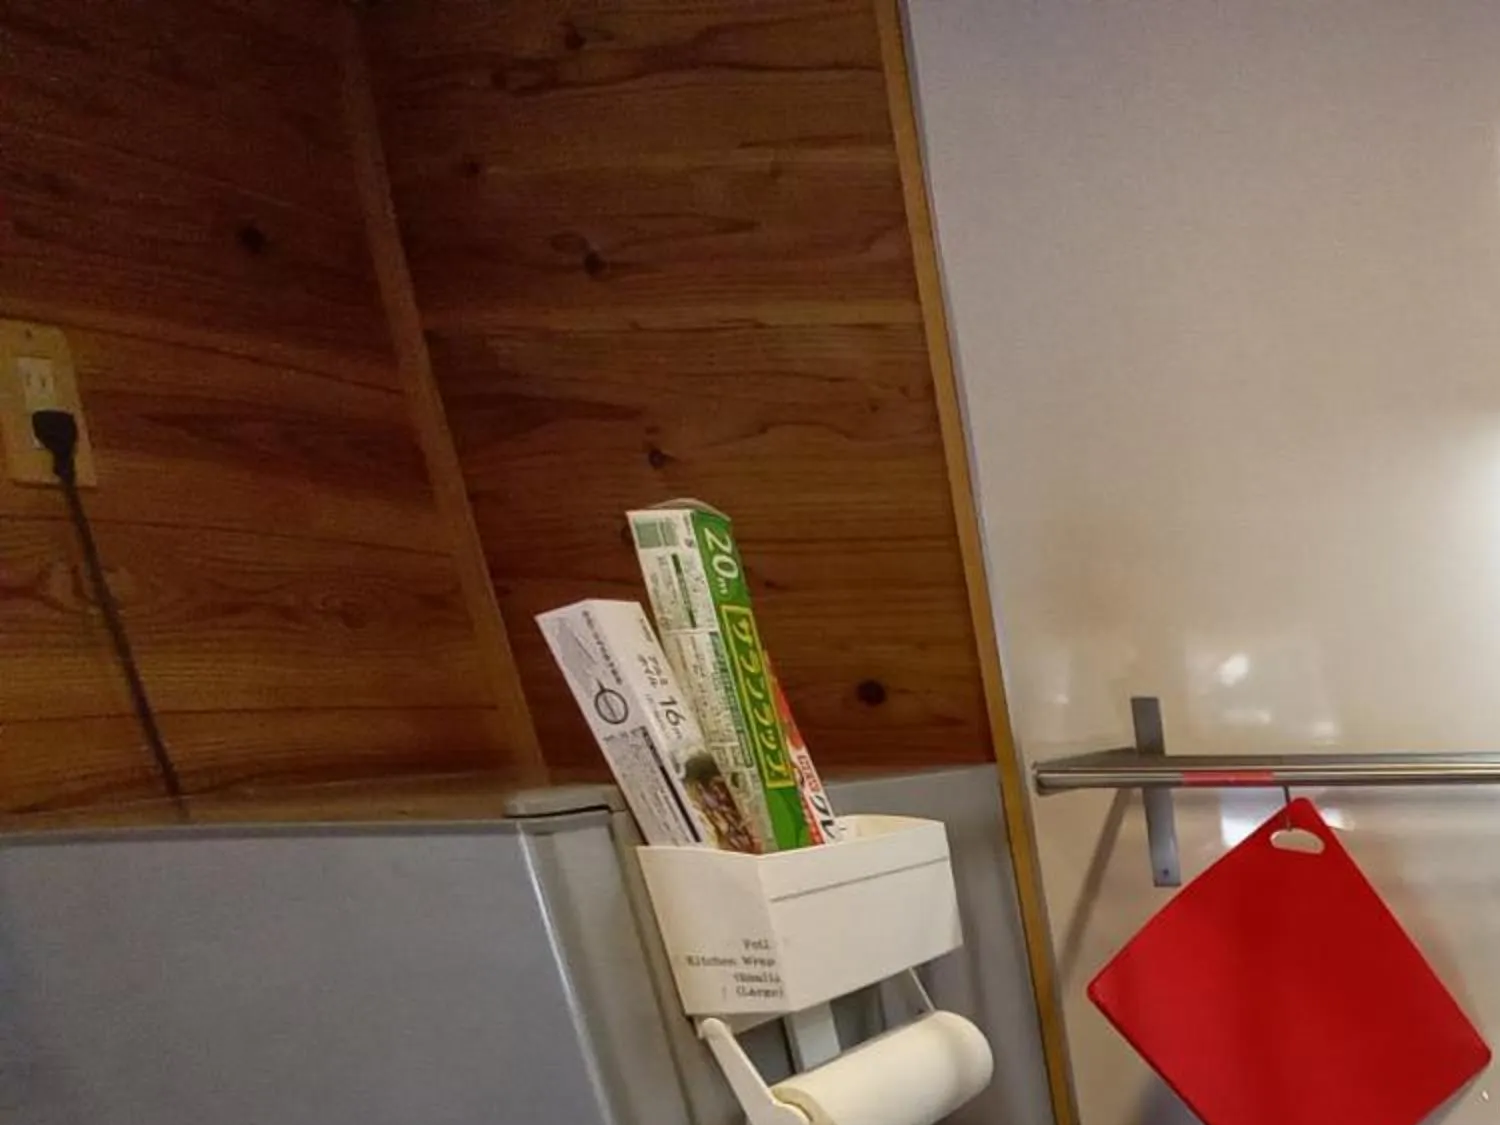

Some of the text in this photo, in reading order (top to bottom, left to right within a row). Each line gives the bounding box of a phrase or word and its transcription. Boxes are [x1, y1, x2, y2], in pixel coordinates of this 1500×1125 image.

[733, 617, 789, 778] サランラップ
[686, 955, 776, 968] Kitchen Wrap
